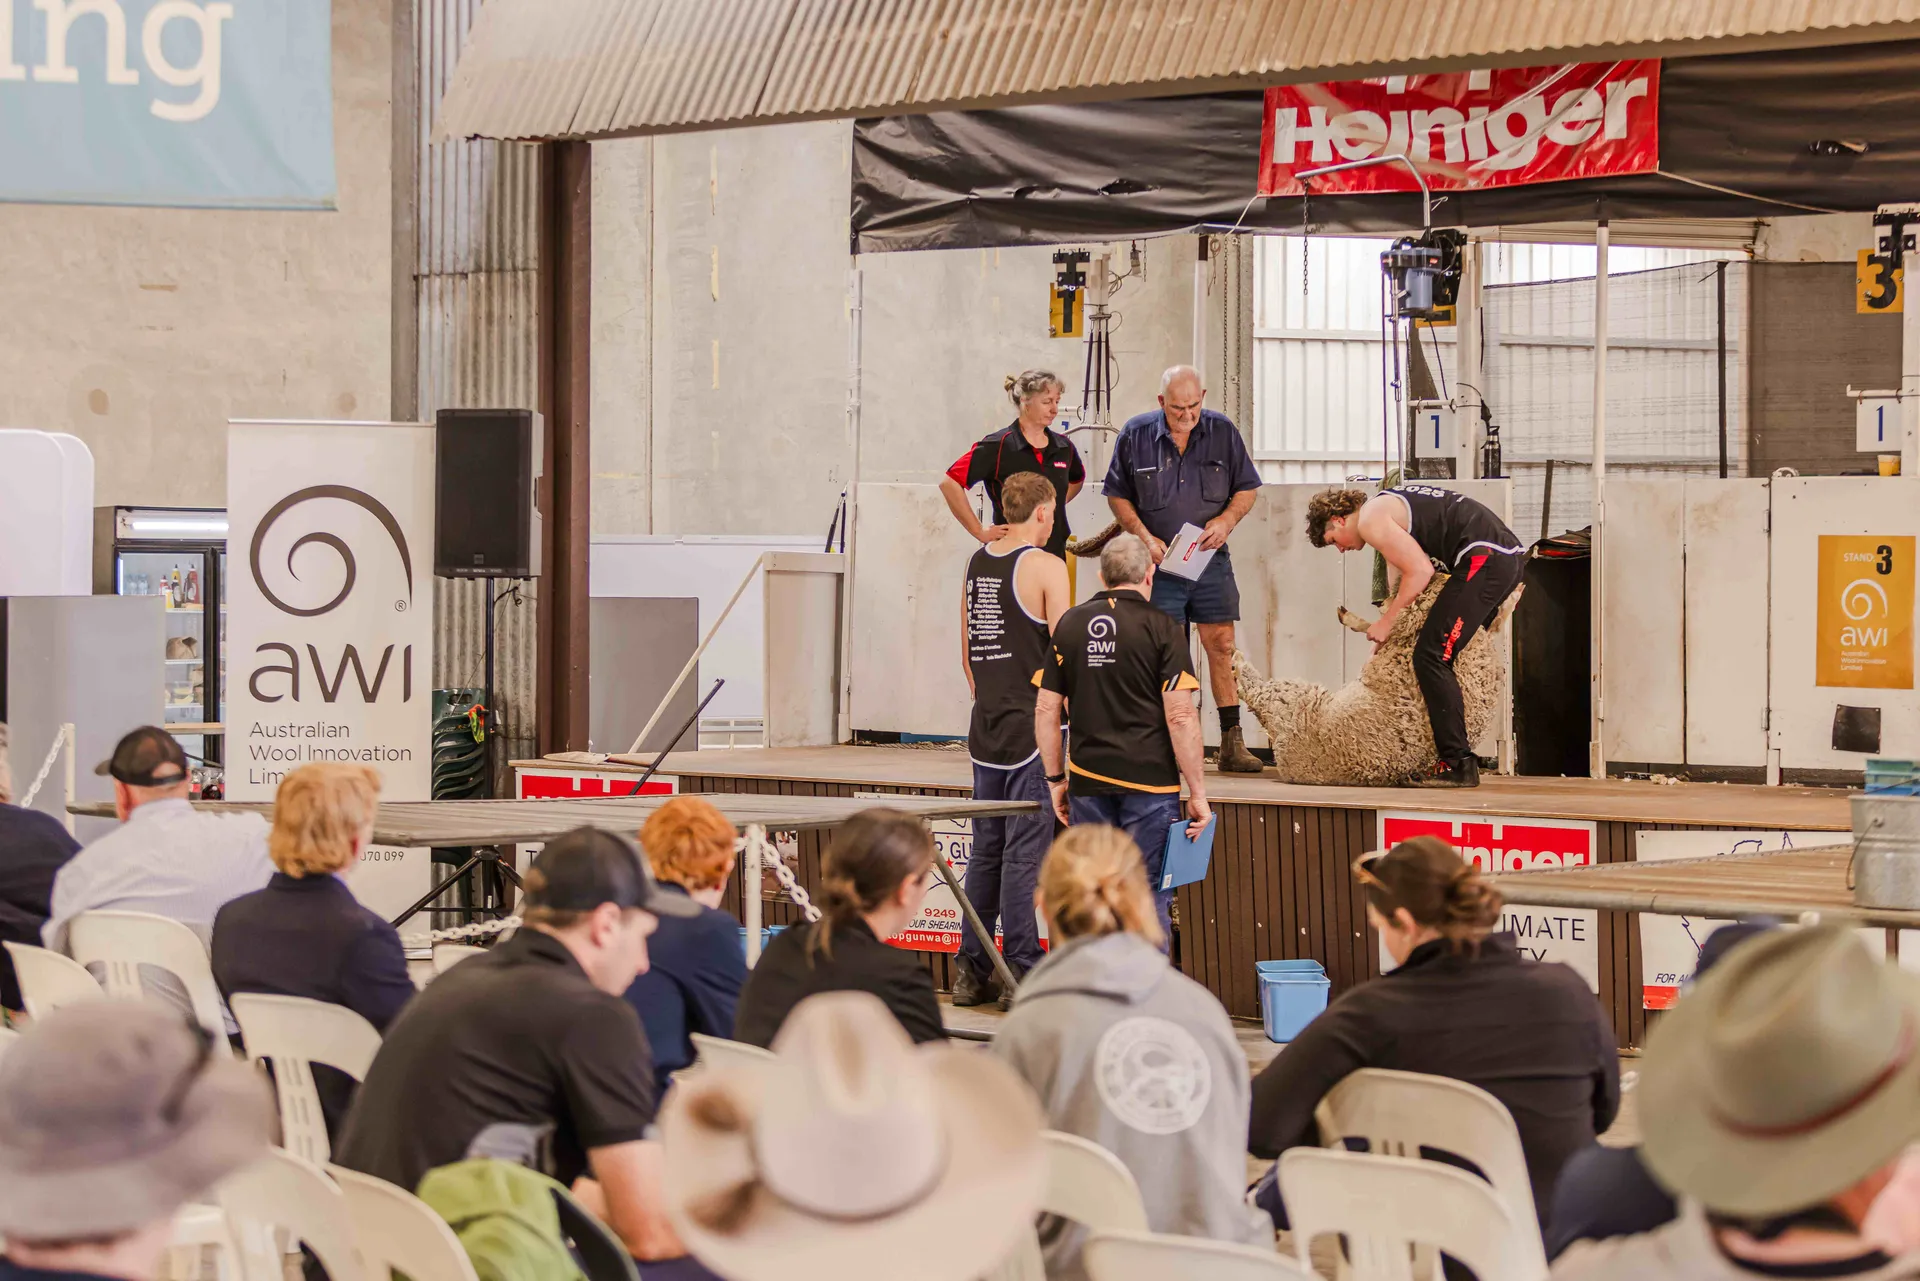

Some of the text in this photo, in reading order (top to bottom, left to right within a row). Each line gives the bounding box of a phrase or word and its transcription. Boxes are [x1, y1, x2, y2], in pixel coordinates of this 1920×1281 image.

[1272, 72, 1650, 171] Heiniger
[1866, 254, 1898, 309] 3
[1430, 414, 1440, 449] 1
[1876, 405, 1884, 442] 1
[1876, 545, 1893, 575] 3
[249, 721, 350, 739] Australian
[249, 744, 412, 762] Wool Innovation
[384, 851, 405, 862] 099
[950, 842, 973, 859] GU
[924, 907, 956, 919] 9249
[909, 919, 962, 931] OUR SHEARIN
[1502, 913, 1586, 942] IMATE
[1655, 973, 1676, 984] FOR
